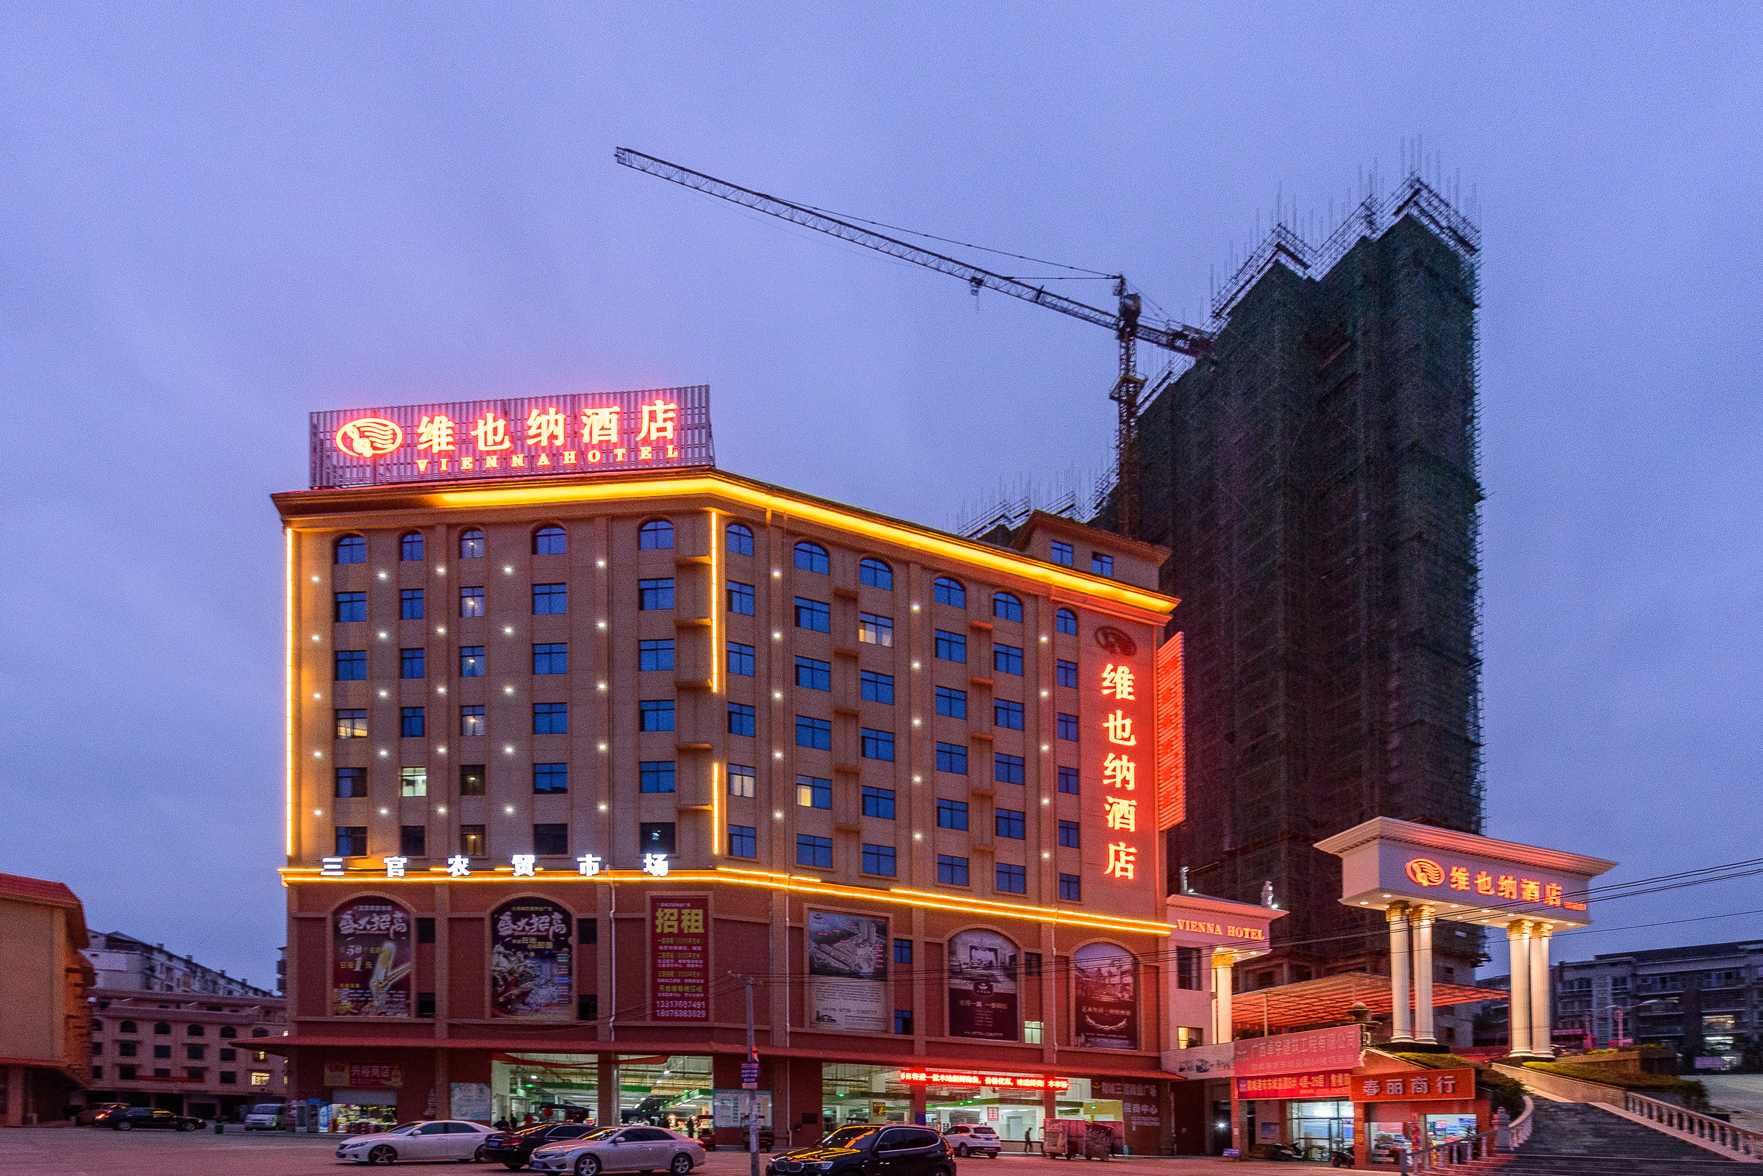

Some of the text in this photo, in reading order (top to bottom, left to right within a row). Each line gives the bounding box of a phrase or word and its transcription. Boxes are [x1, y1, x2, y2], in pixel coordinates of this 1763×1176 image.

[416, 400, 678, 453] 维也纳酒店
[1101, 663, 1137, 880] 维也纳酒店
[320, 853, 669, 877] 三官农贸市场
[1449, 866, 1562, 907] 维也纳酒店
[656, 908, 704, 933] 招租
[1177, 919, 1265, 940] VIENNA HOTEL
[1363, 1076, 1456, 1096] 春丽商行
